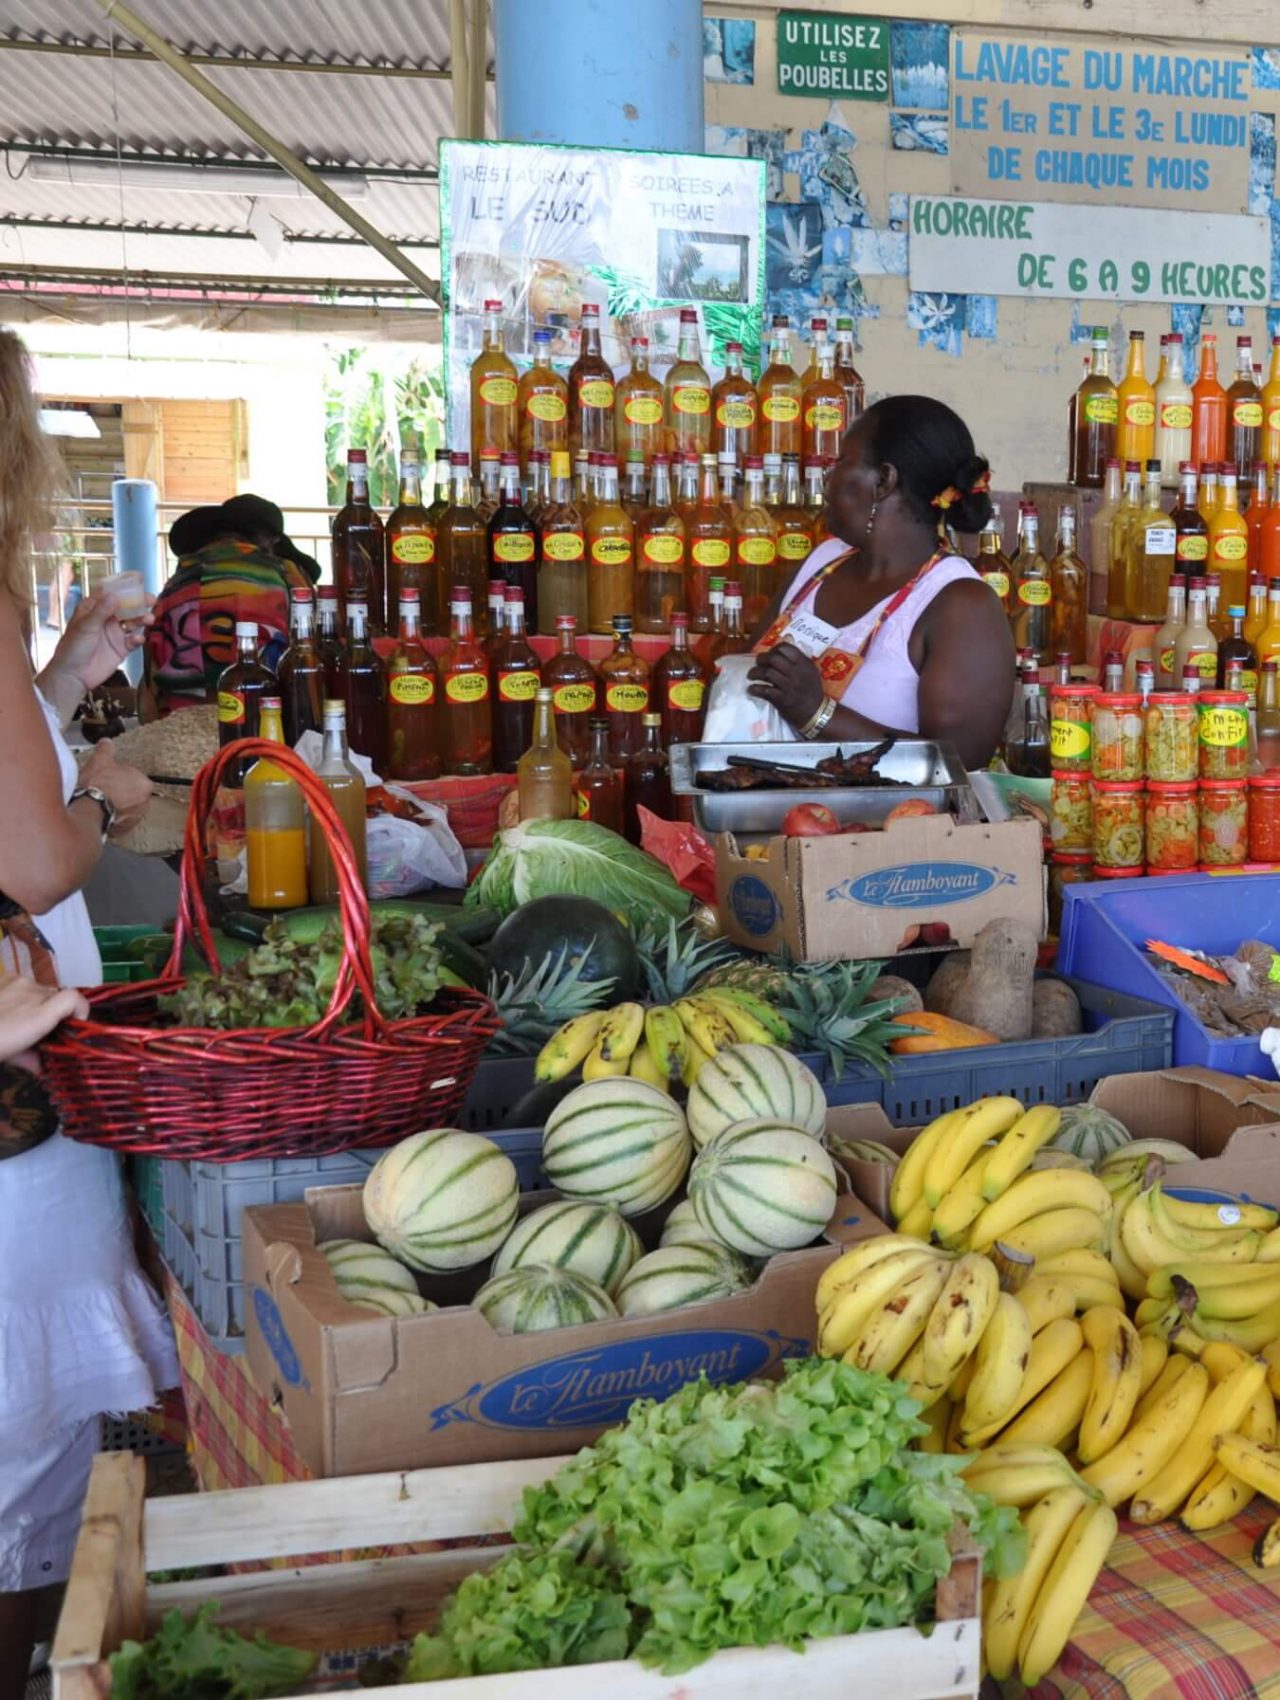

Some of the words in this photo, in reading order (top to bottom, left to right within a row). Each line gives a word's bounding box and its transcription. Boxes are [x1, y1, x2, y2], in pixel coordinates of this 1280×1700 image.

[785, 20, 881, 50] UTILISEZ
[820, 49, 848, 64] LES
[955, 39, 1070, 89] LAVAGE
[1083, 49, 1123, 92] DU
[1132, 52, 1250, 102] MARCHE
[779, 63, 889, 93] POUBELLES
[954, 94, 989, 131] LE
[1002, 98, 1037, 135] 1ER
[1048, 101, 1082, 137] ET
[1092, 104, 1126, 140] LE
[1134, 107, 1165, 143] 3E
[1174, 110, 1247, 148] LUNDI
[987, 145, 1022, 181] DE
[1034, 149, 1134, 190] CHAQUE
[1146, 155, 1211, 192] MOIS
[470, 195, 505, 222] LE
[912, 200, 1035, 240] HORAIRE
[1017, 252, 1056, 289] DE
[1067, 257, 1088, 294] 6
[1098, 258, 1119, 293] A
[1130, 260, 1151, 295] 9
[1161, 261, 1267, 301] HEURES
[879, 867, 979, 897] Flamboyant
[543, 1341, 741, 1415] Flamboyant
